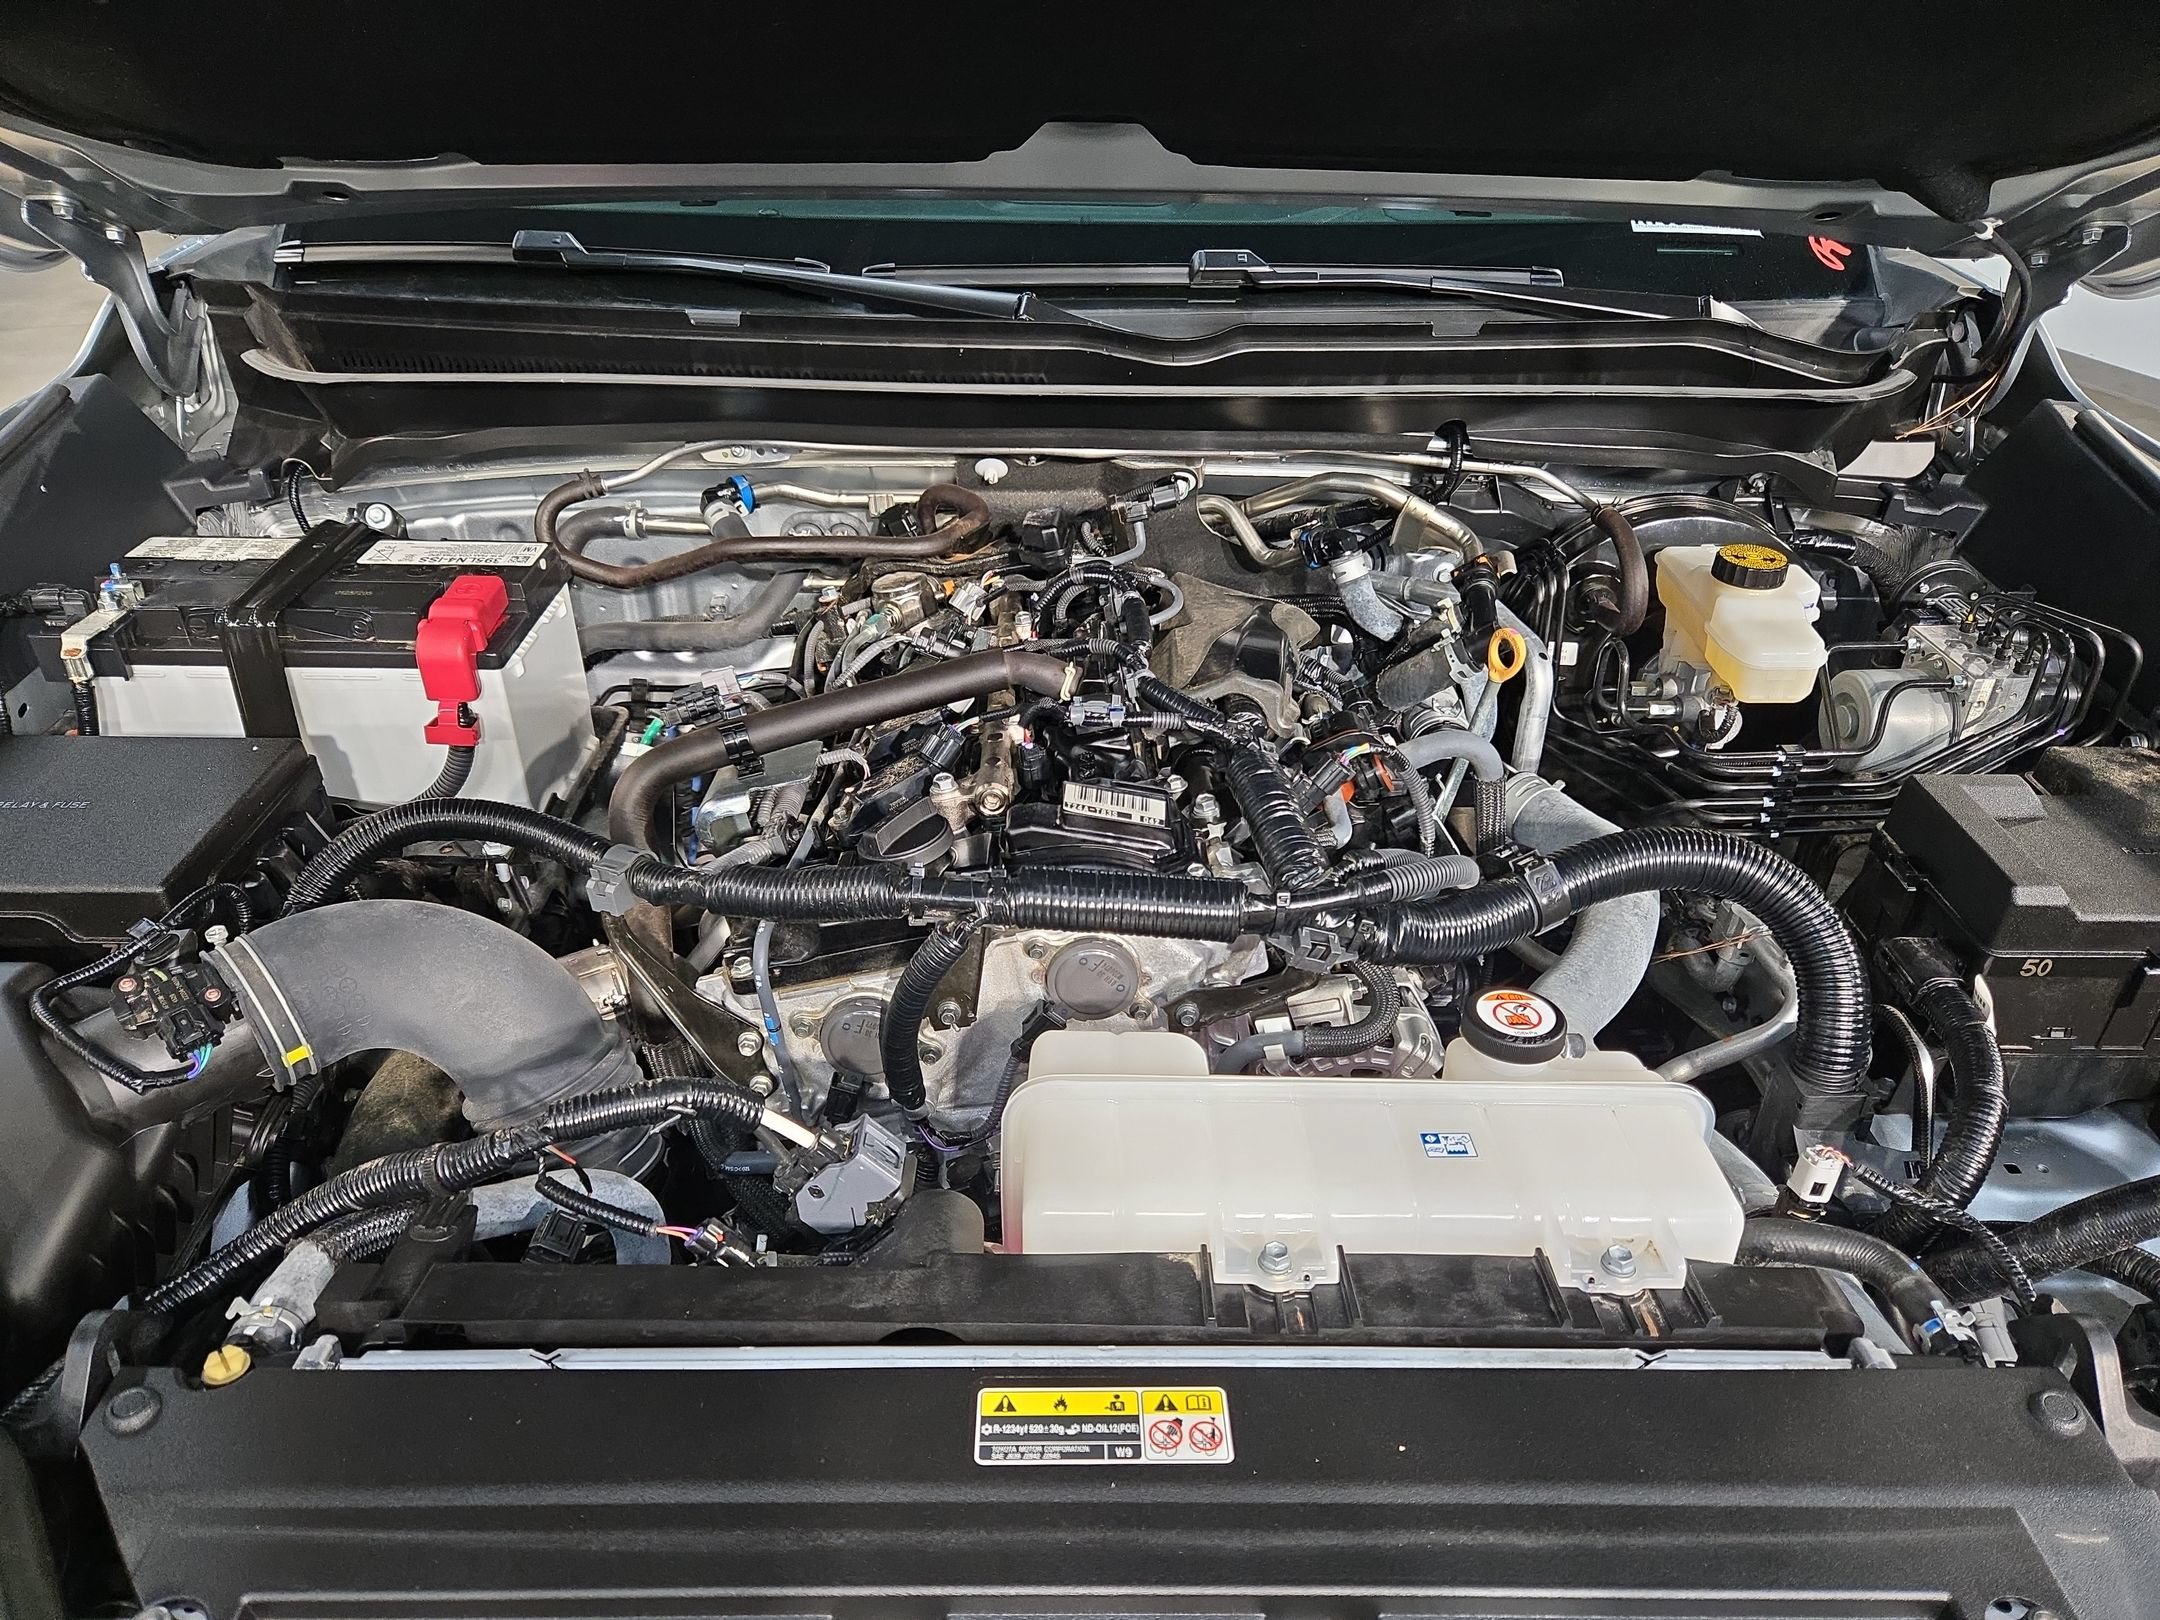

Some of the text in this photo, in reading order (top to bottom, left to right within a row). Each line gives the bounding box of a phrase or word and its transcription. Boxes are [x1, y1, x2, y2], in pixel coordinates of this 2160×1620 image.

[51, 801, 90, 809] FUSE
[2019, 958, 2053, 977] 50
[991, 1445, 1090, 1453] TOYOTA MOTOR CORPORATION
[1114, 1446, 1133, 1458] W9
